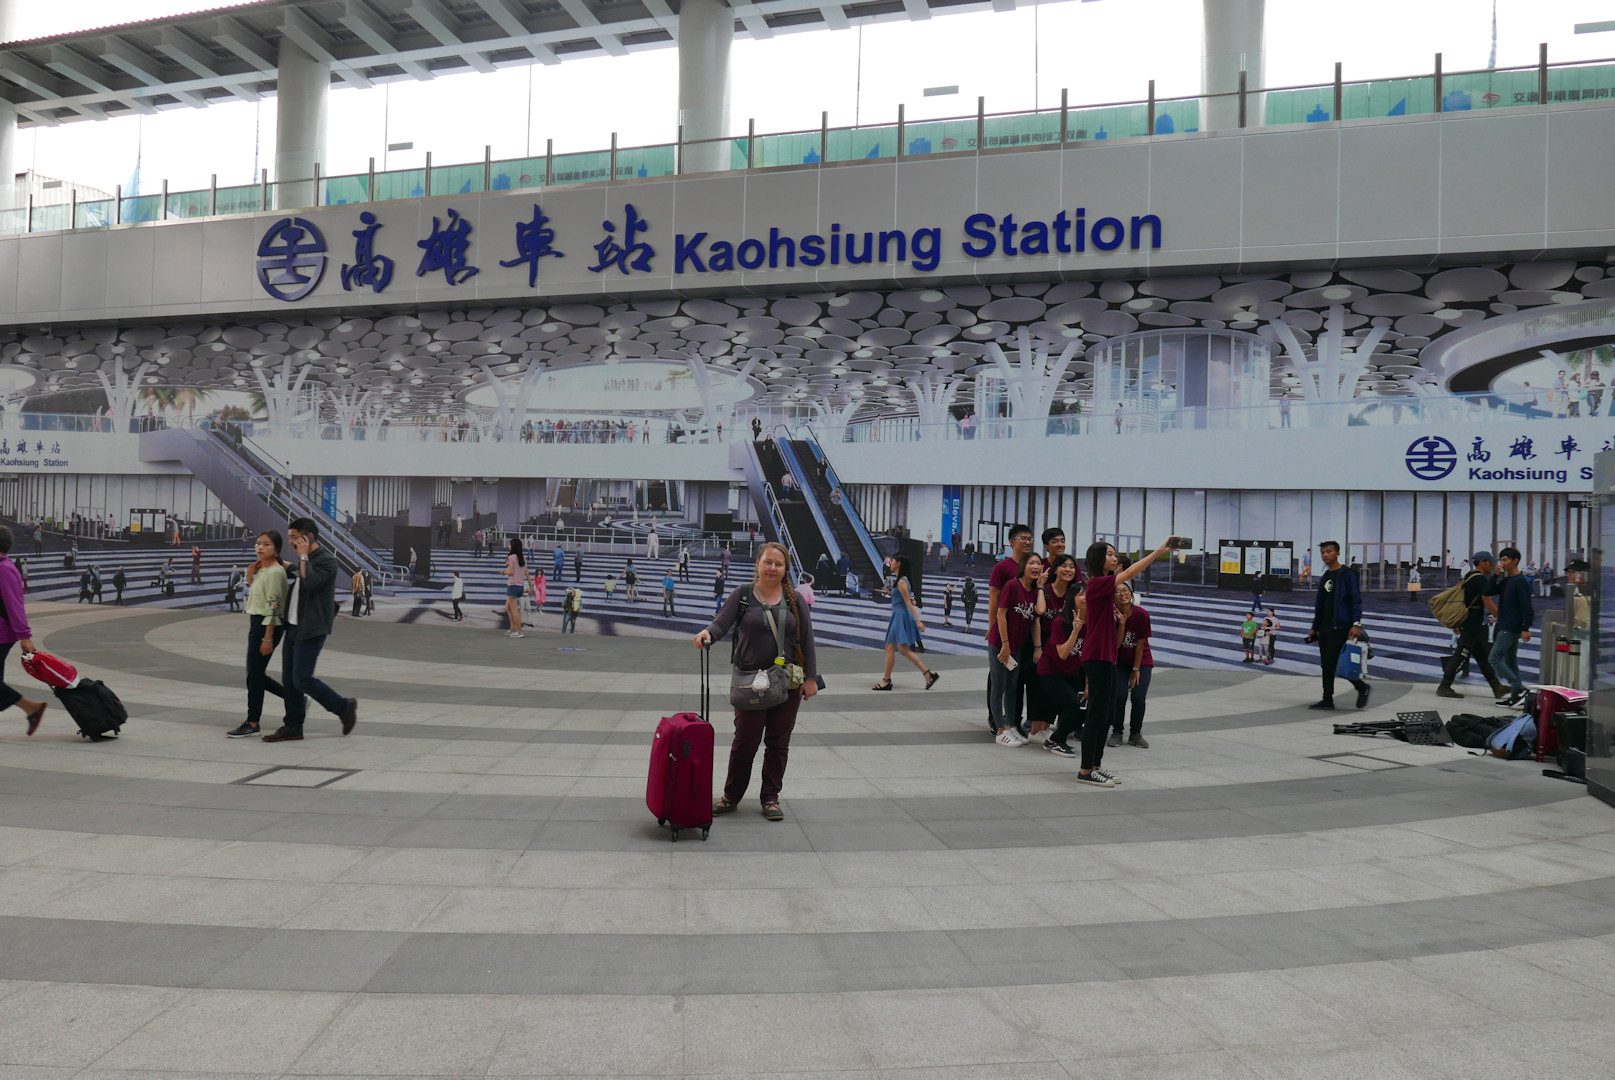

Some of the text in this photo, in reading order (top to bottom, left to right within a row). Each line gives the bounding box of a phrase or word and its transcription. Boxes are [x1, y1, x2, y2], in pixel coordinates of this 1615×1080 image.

[340, 203, 1162, 293] 高雄車站 Kaohsiung Station
[1466, 435, 1615, 463] 高雄車
[0, 458, 69, 468] Kaohsiung Station
[1469, 467, 1567, 483] Kaohsiung
